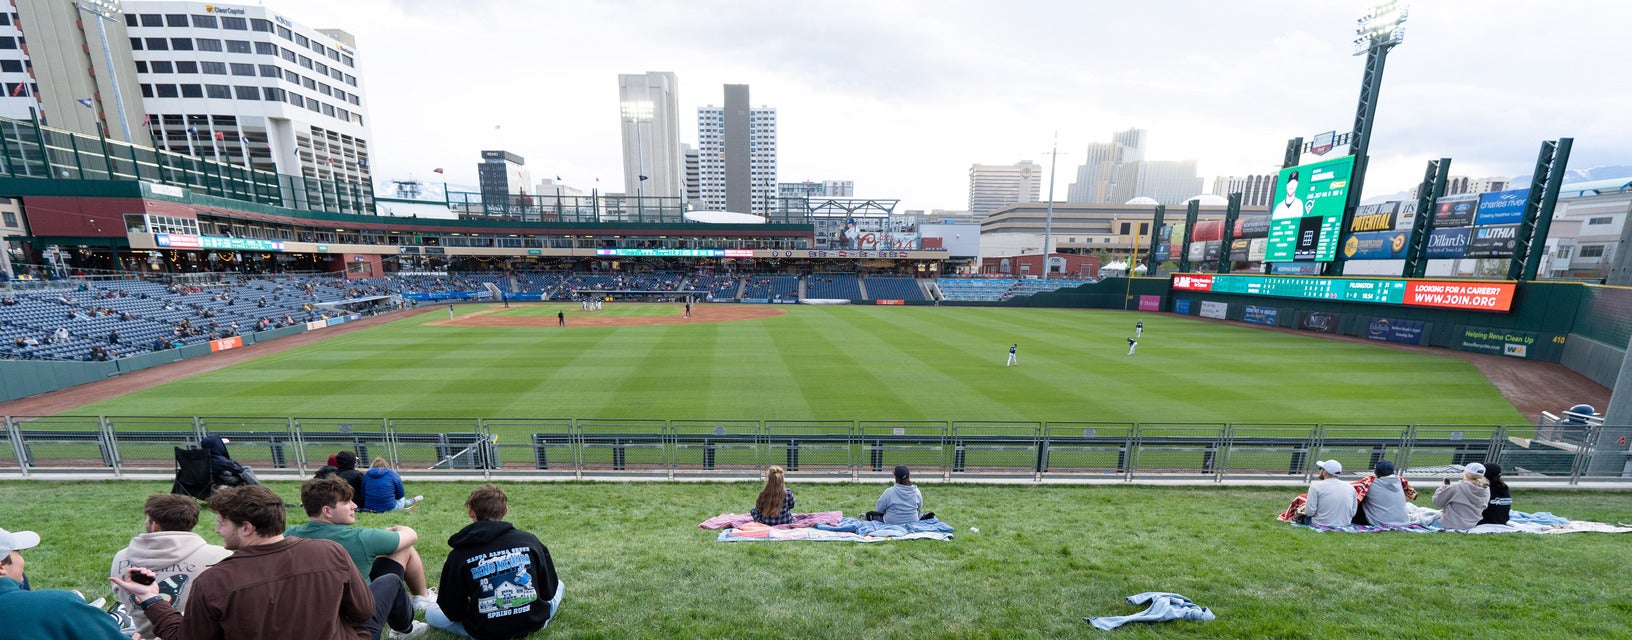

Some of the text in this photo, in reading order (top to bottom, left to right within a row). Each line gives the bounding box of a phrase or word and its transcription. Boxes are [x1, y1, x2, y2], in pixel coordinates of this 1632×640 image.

[1480, 198, 1527, 209] charles river
[1350, 213, 1392, 232] POTENTIAL
[1486, 227, 1516, 239] LITHIA
[1428, 233, 1466, 248] Dillard's
[1415, 285, 1501, 296] LOOKING FOR A CAREER?
[1415, 293, 1497, 307] WWW.JOIN.ORG
[1465, 330, 1534, 344] Helping Reno Clean Up
[1552, 335, 1566, 344] 410
[466, 553, 487, 564] KAPPA
[489, 549, 510, 558] ALPHA
[471, 554, 531, 579] RENO NEVADA
[483, 584, 493, 592] 24
[487, 605, 531, 618] SPRING RUSH
